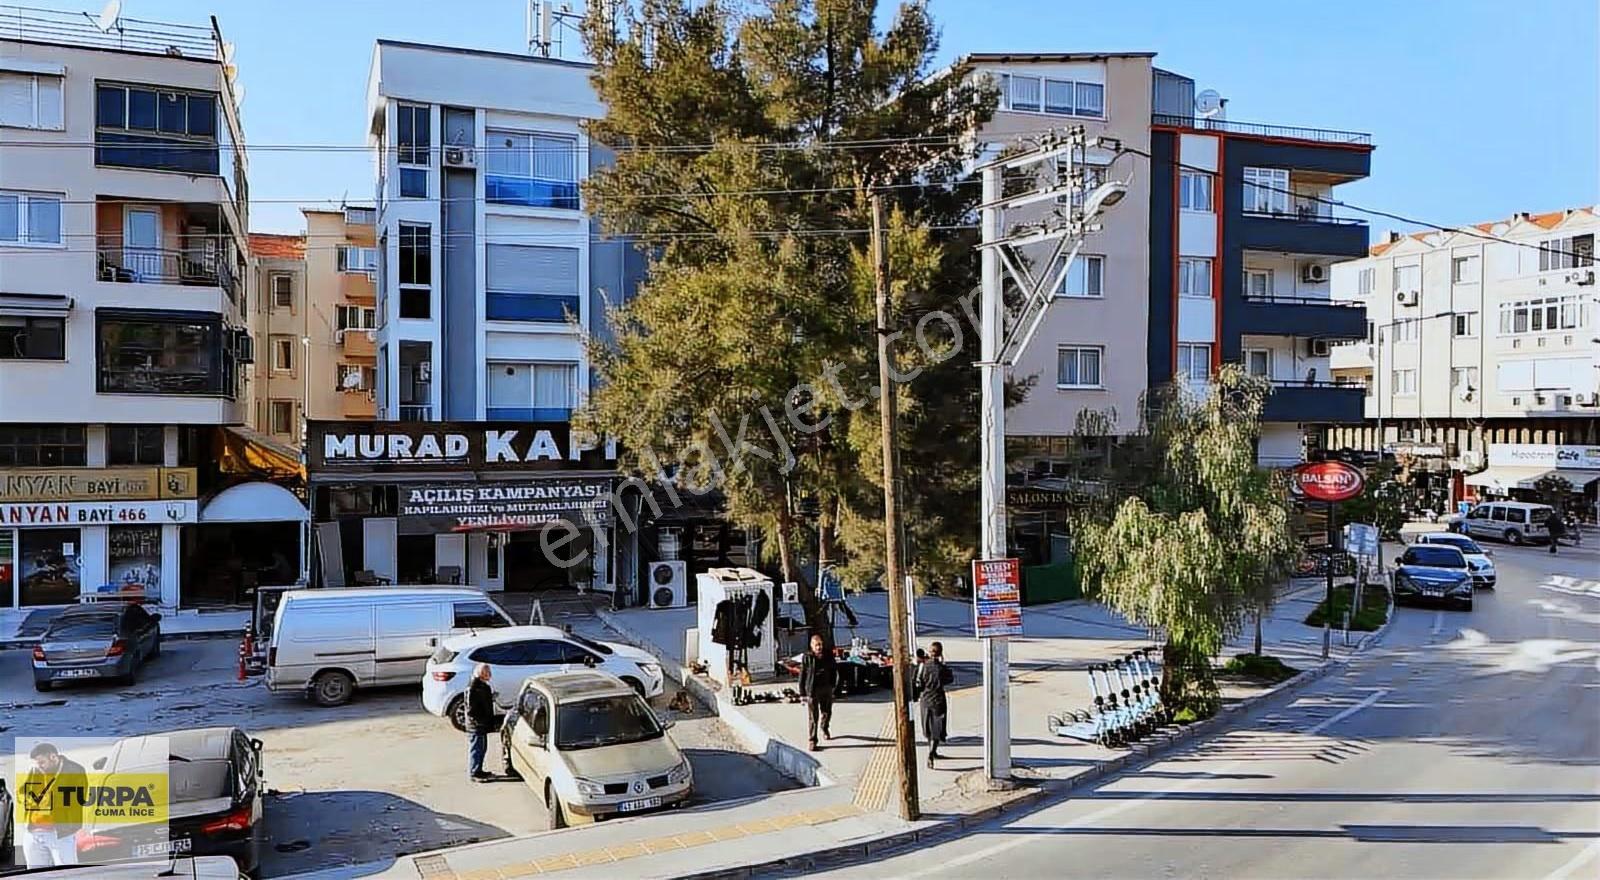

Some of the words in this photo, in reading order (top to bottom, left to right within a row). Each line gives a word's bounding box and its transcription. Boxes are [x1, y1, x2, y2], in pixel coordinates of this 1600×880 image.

[324, 434, 469, 459] MURAD
[0, 475, 77, 496] NYAN
[87, 478, 120, 494] BAYİ
[409, 487, 475, 505] AÇILIŞ
[479, 485, 603, 501] KAMPANYASI
[78, 505, 114, 522] BAYİ
[118, 508, 147, 521] 466
